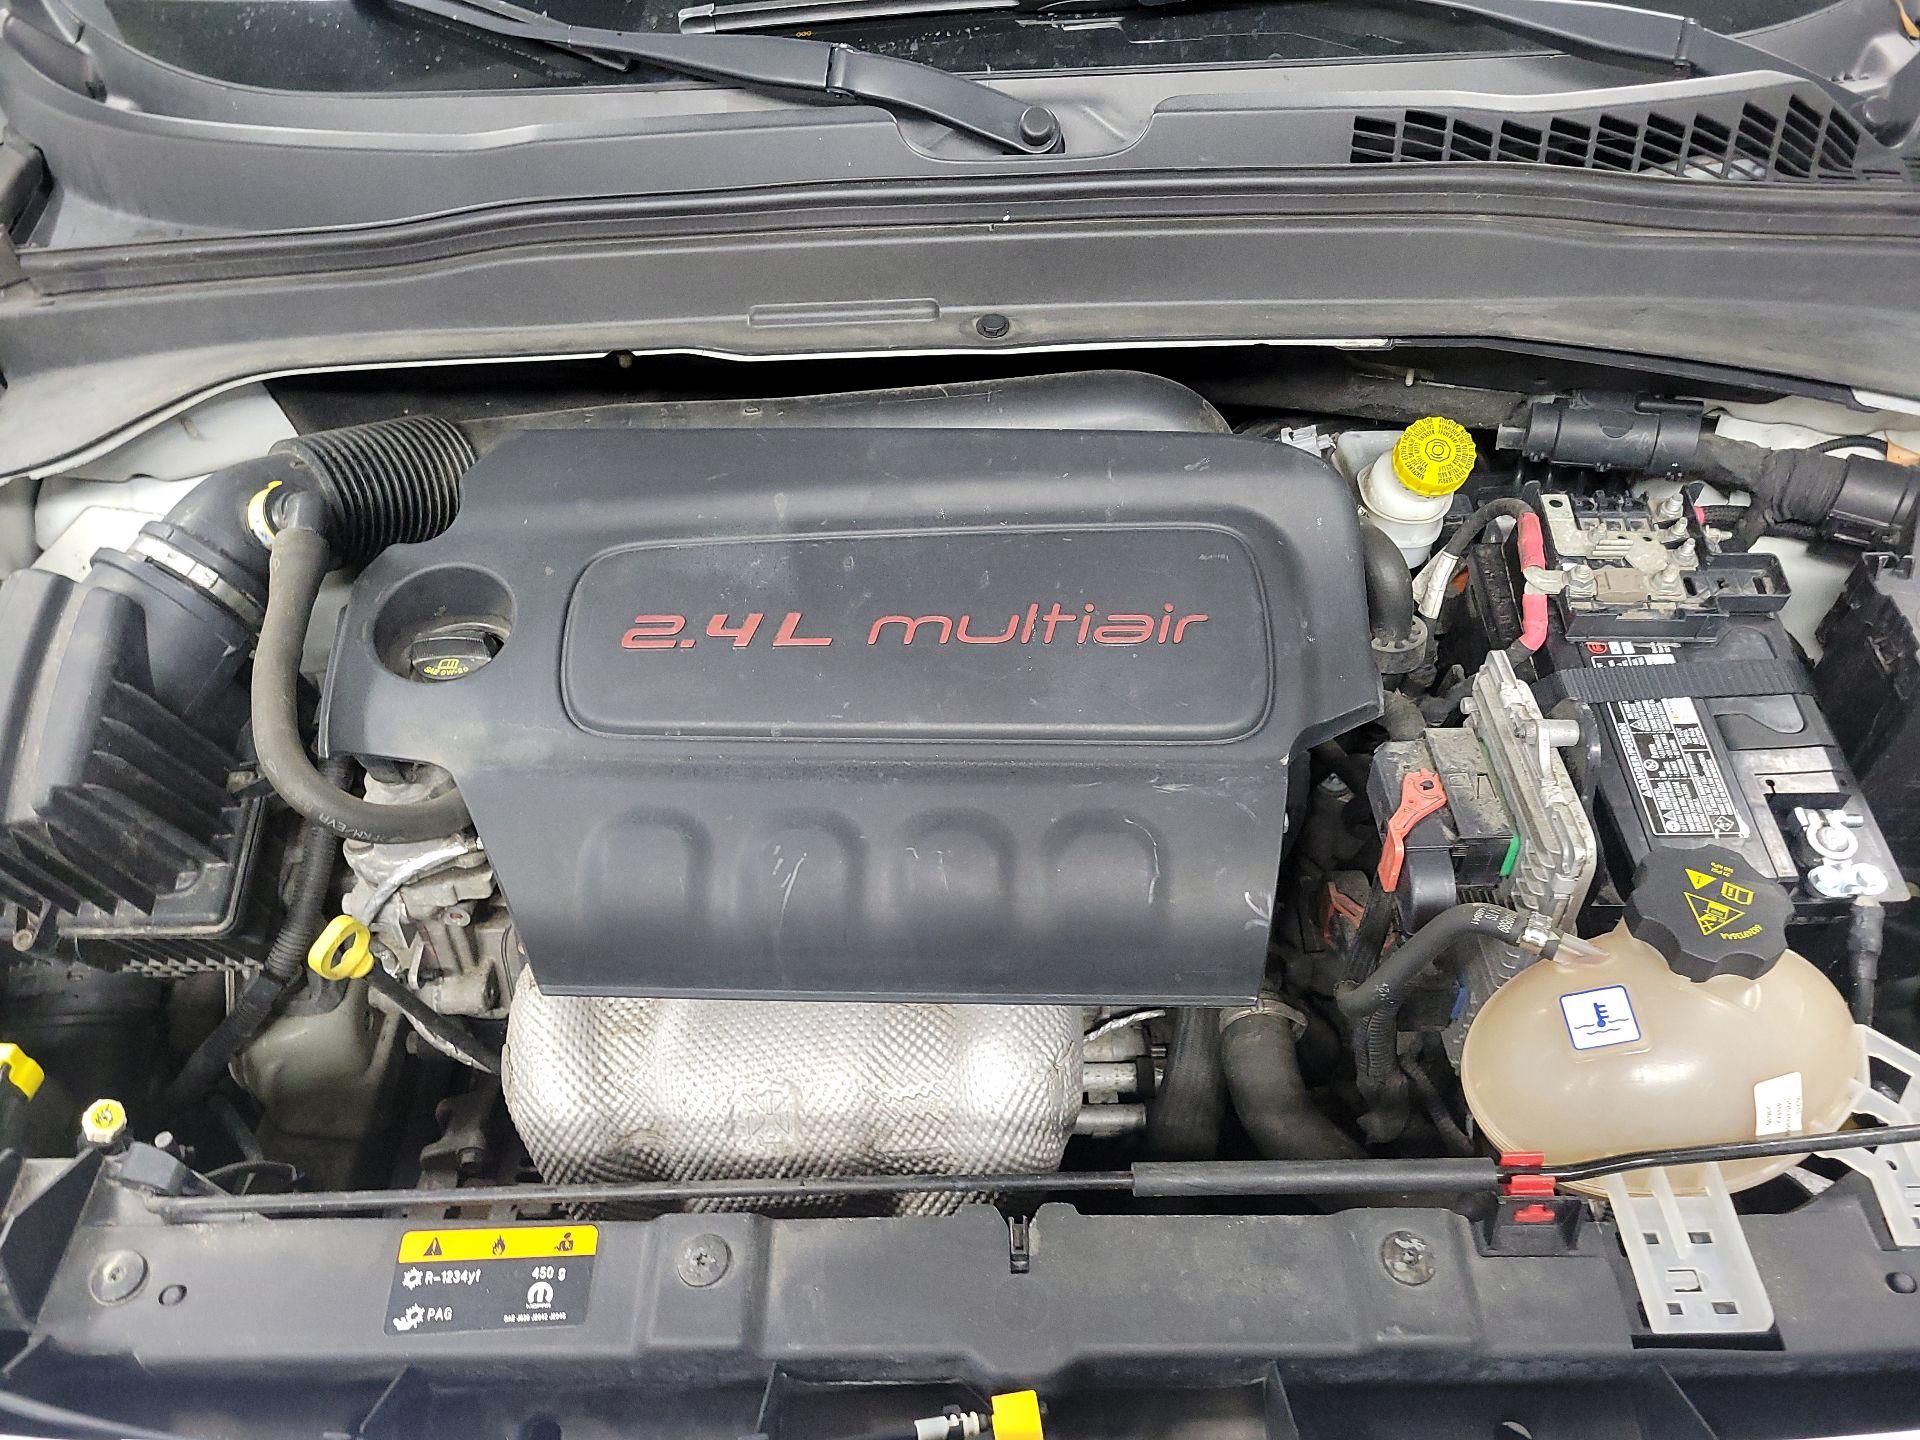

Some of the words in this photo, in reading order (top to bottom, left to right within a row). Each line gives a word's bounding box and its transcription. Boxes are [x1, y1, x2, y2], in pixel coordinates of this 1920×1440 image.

[866, 602, 1209, 645] multiair
[425, 1268, 481, 1286] R-1234yf
[532, 1266, 554, 1279] 450
[558, 1267, 567, 1281] g
[427, 1306, 453, 1321] PAG
